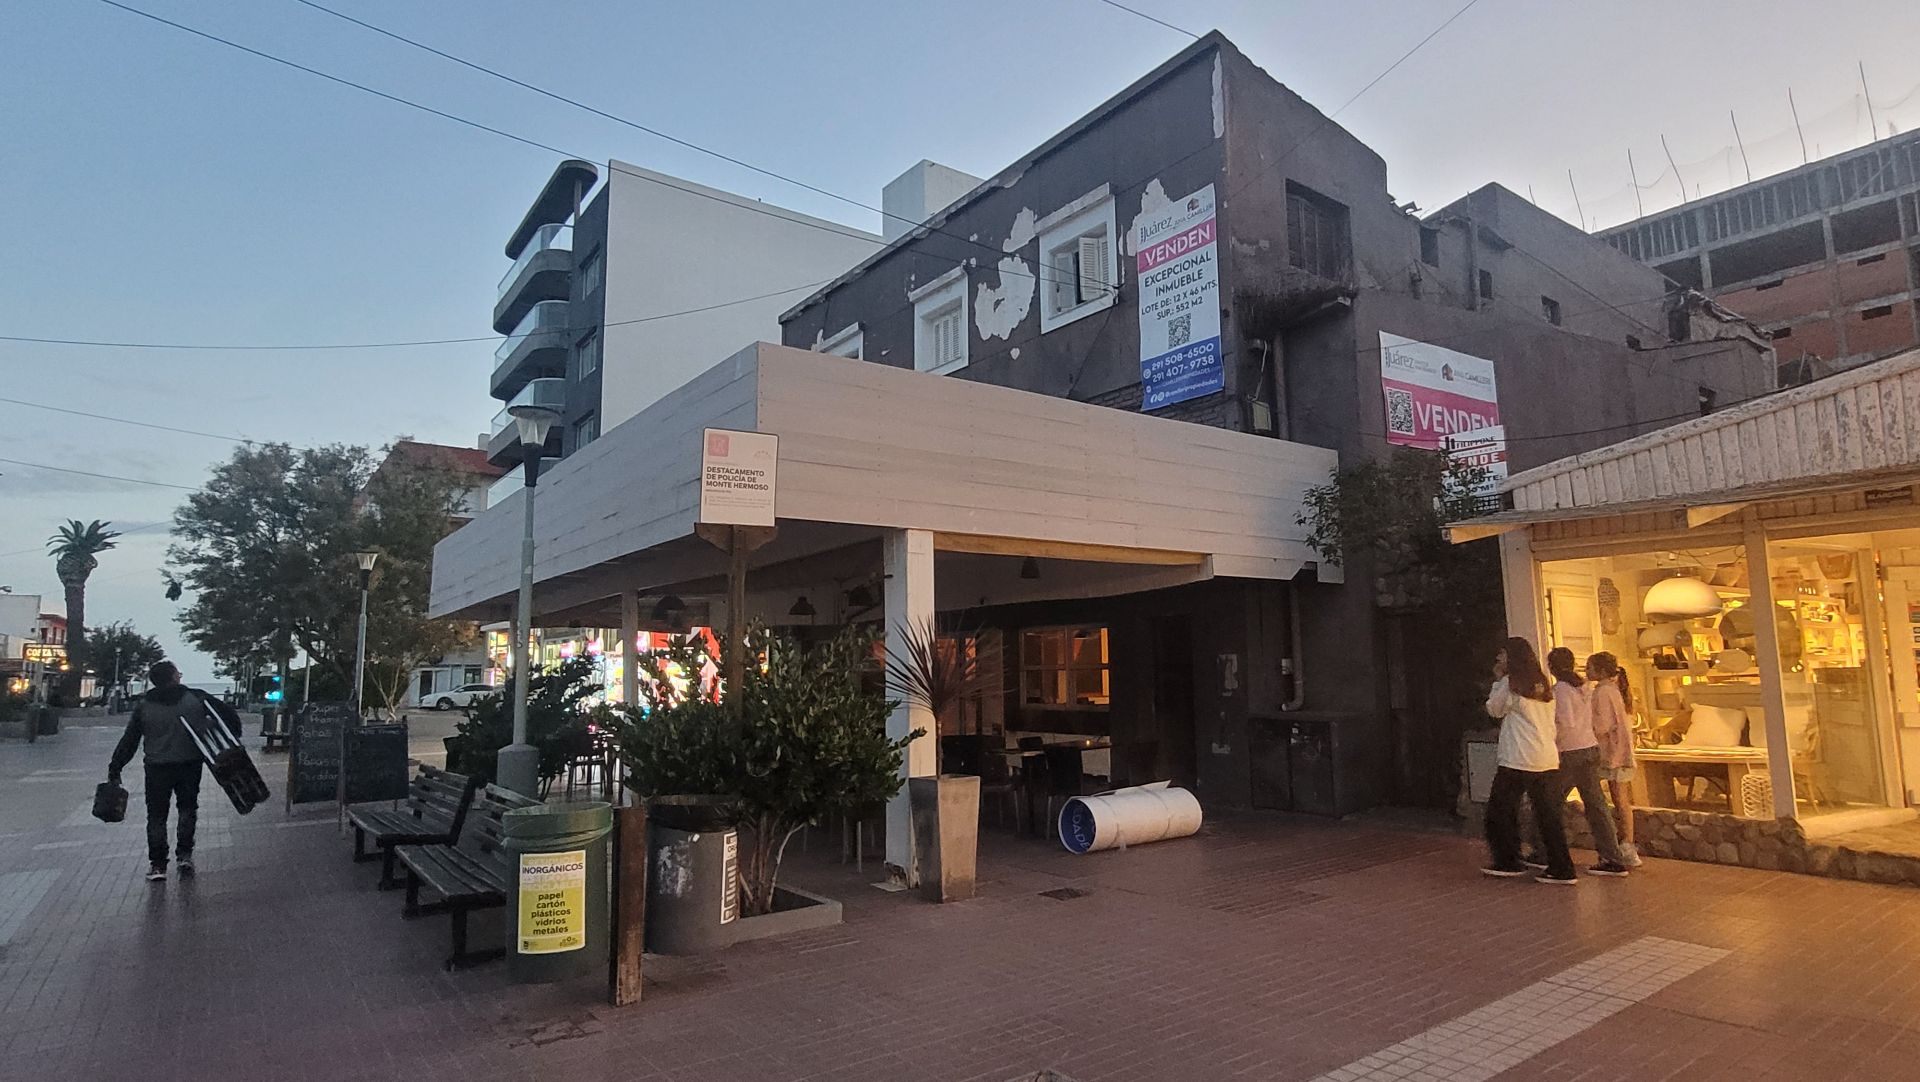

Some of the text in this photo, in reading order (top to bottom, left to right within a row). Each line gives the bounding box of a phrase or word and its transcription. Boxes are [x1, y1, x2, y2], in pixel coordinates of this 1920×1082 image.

[1145, 224, 1210, 265] VENDEN
[1144, 251, 1212, 287] EXCEPCIONAL
[1155, 268, 1204, 297] INMUEBLE
[1141, 279, 1218, 315] LOTE DE: 12 X 46 MTS.
[1175, 301, 1190, 313] 552
[1191, 296, 1204, 308] M2
[1151, 342, 1214, 371] 291 508-6500
[1152, 372, 1165, 383] 291
[706, 466, 765, 477] DESTACAMENTO
[717, 474, 746, 483] POLICÍA
[706, 480, 769, 491] MONTE HERMOSO
[522, 862, 584, 875] INORGÁNICOS
[538, 890, 564, 902] papel
[536, 899, 566, 909] cartón
[531, 908, 571, 919] plásticos
[535, 917, 566, 926] vidrios
[533, 925, 569, 936] metales
